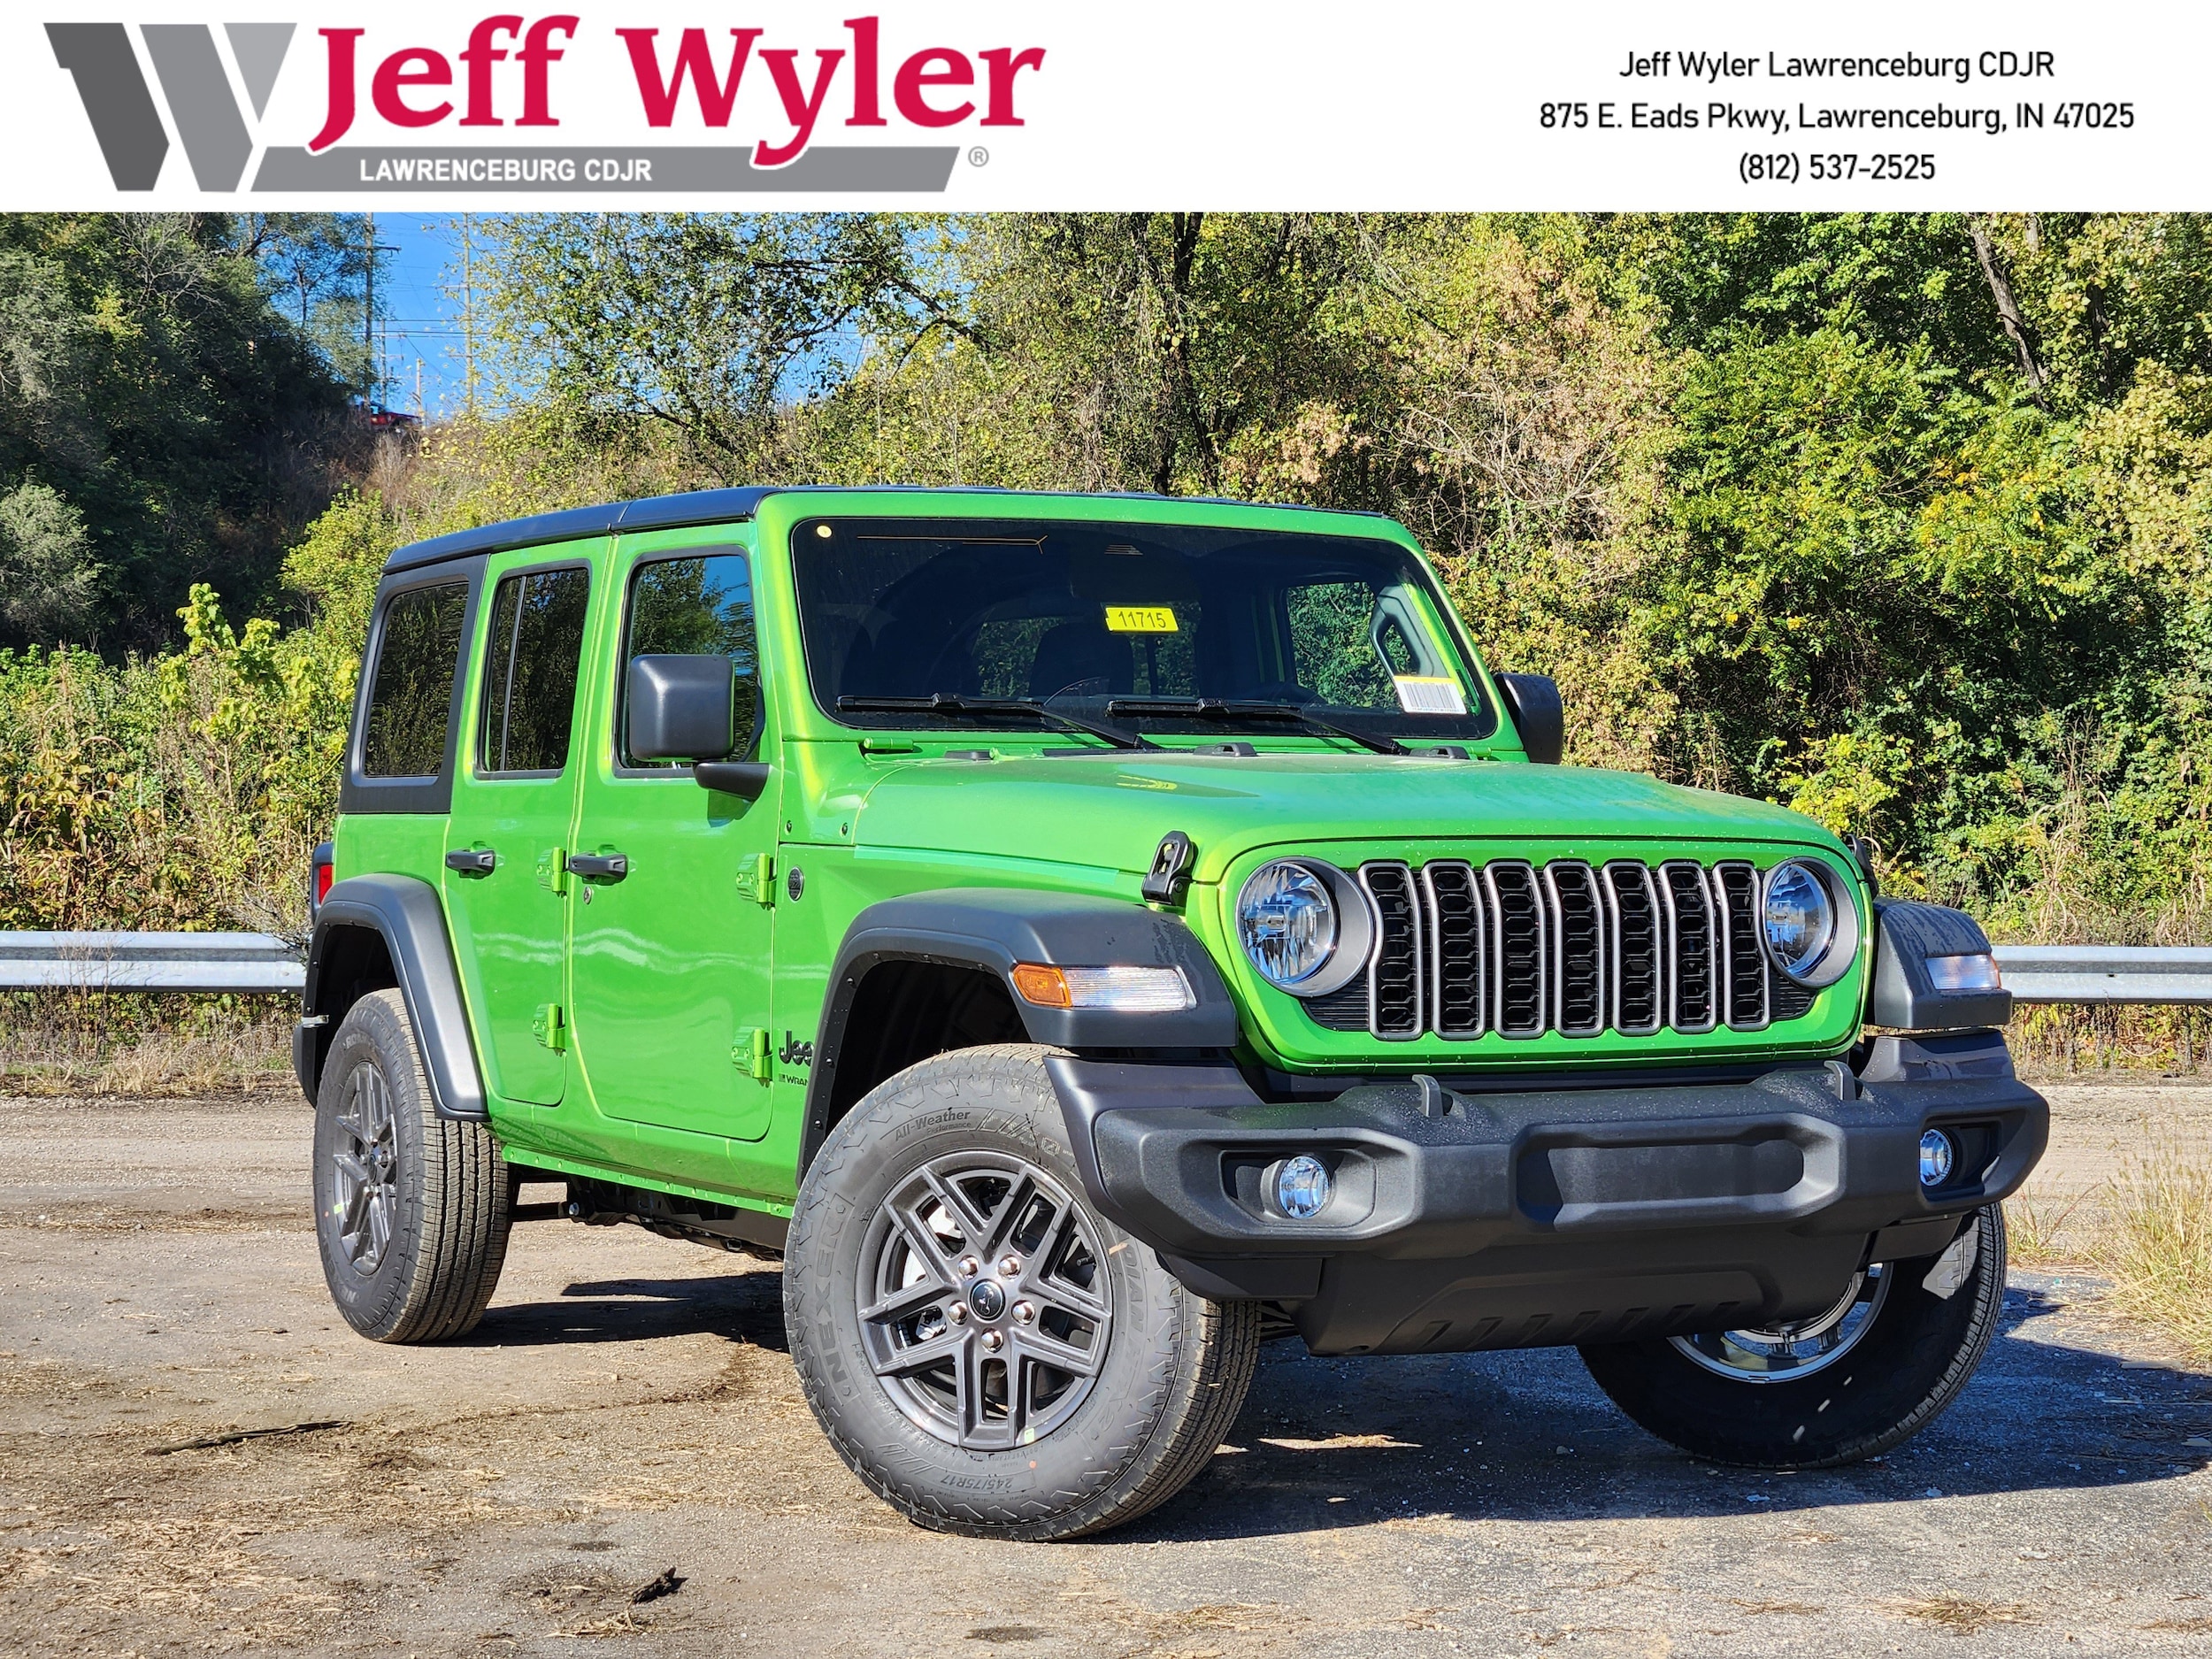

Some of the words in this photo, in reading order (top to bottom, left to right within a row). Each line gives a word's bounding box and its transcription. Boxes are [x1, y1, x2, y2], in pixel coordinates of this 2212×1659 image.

[1118, 611, 1166, 628] 11715
[779, 1030, 814, 1067] Jee
[895, 1110, 971, 1141] All-Weather
[815, 1215, 848, 1384] NEXEN
[940, 1474, 1014, 1491] 245/75R17
